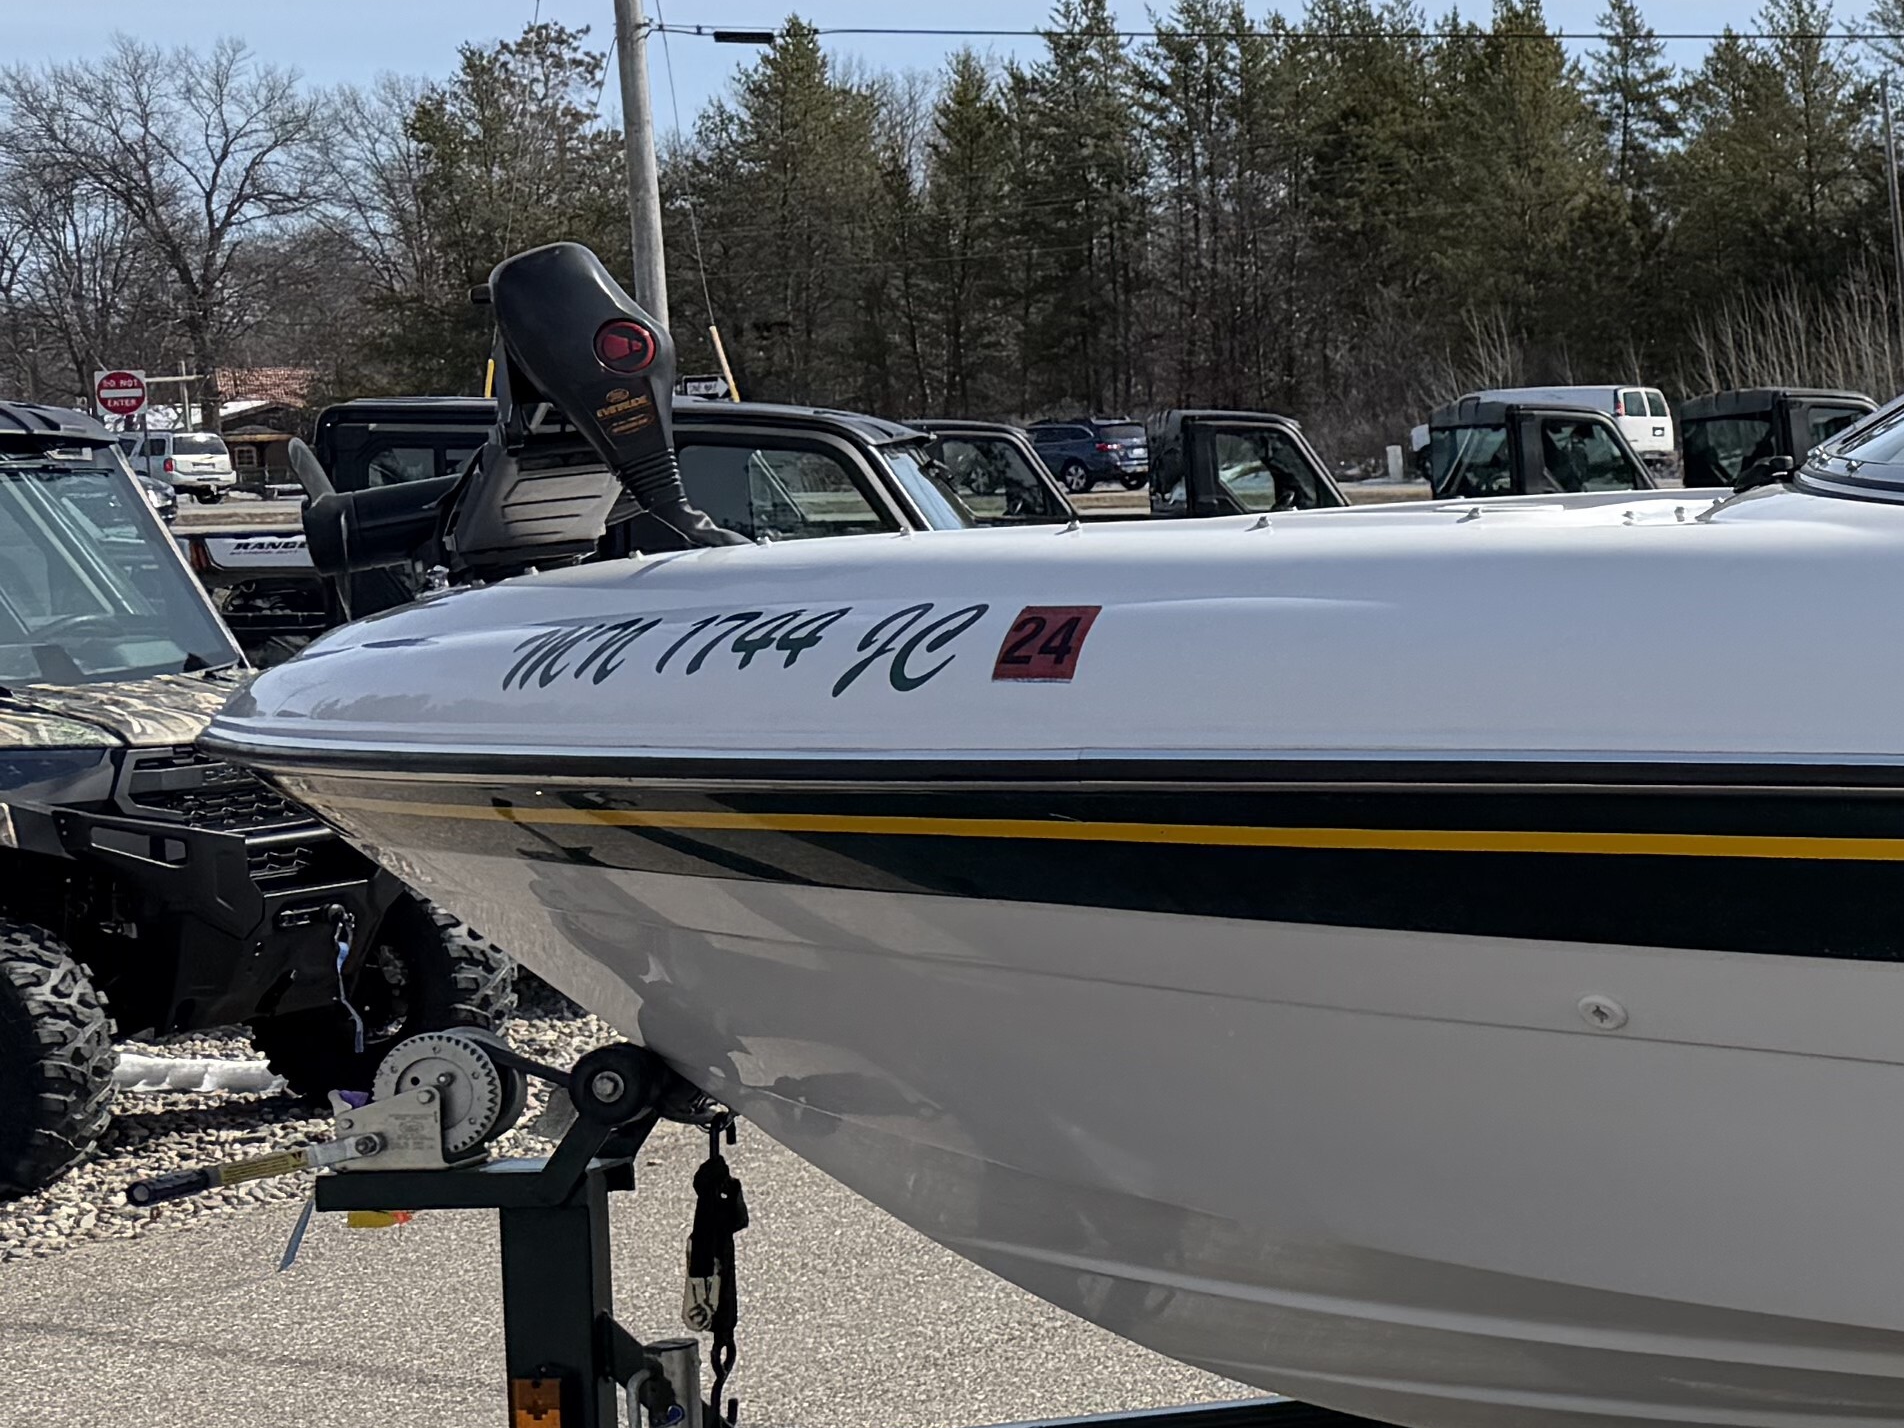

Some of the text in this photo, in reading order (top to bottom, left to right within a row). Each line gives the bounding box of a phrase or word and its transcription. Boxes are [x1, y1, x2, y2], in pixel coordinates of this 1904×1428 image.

[103, 379, 138, 388] DO NOT
[107, 399, 136, 407] ENTER
[233, 541, 307, 551] RANGE
[1000, 616, 1082, 666] 24
[502, 602, 990, 698] MN 1744 JC
